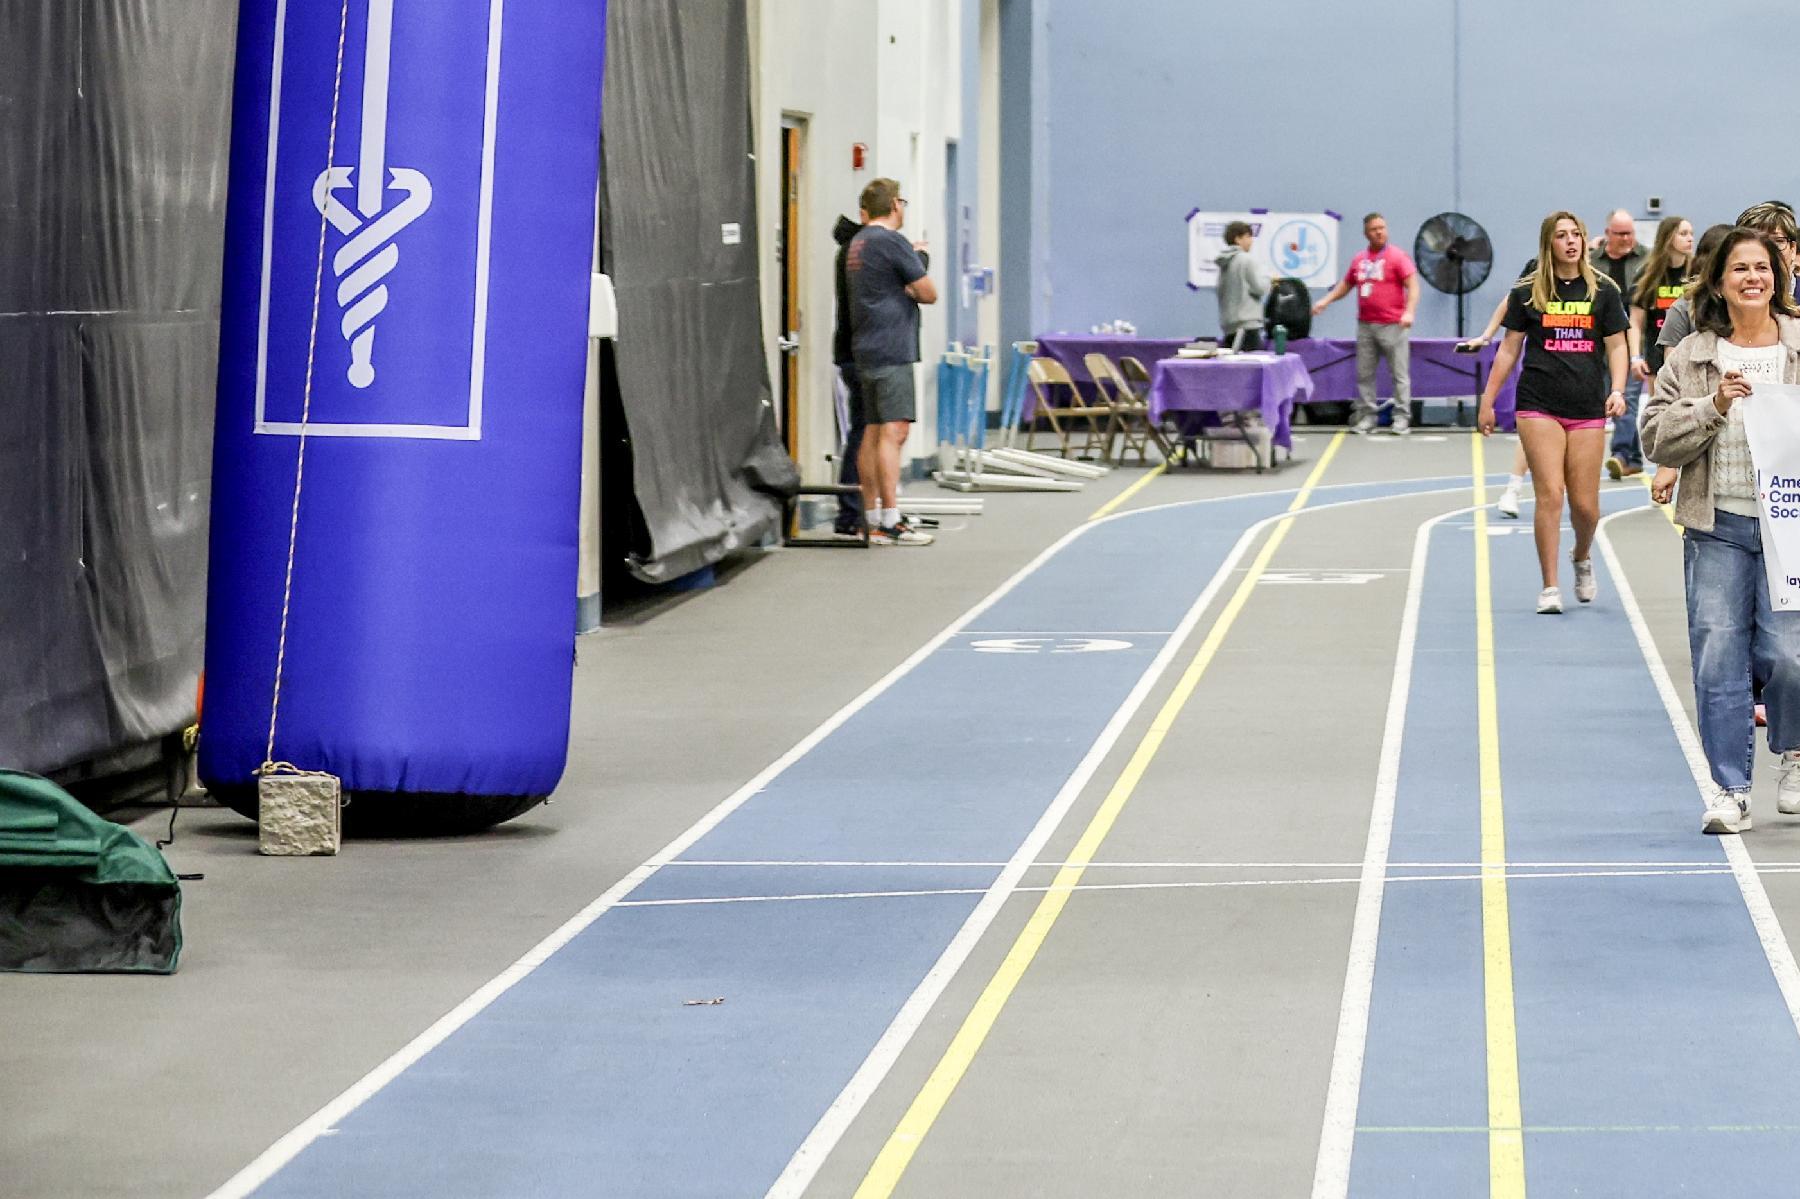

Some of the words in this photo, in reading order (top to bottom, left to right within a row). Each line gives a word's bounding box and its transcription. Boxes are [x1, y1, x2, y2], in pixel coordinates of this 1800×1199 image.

[1546, 301, 1592, 314] GLOW
[1542, 314, 1595, 328] BRIGHTER
[1554, 327, 1583, 339] THAN
[1544, 340, 1595, 352] CANCER
